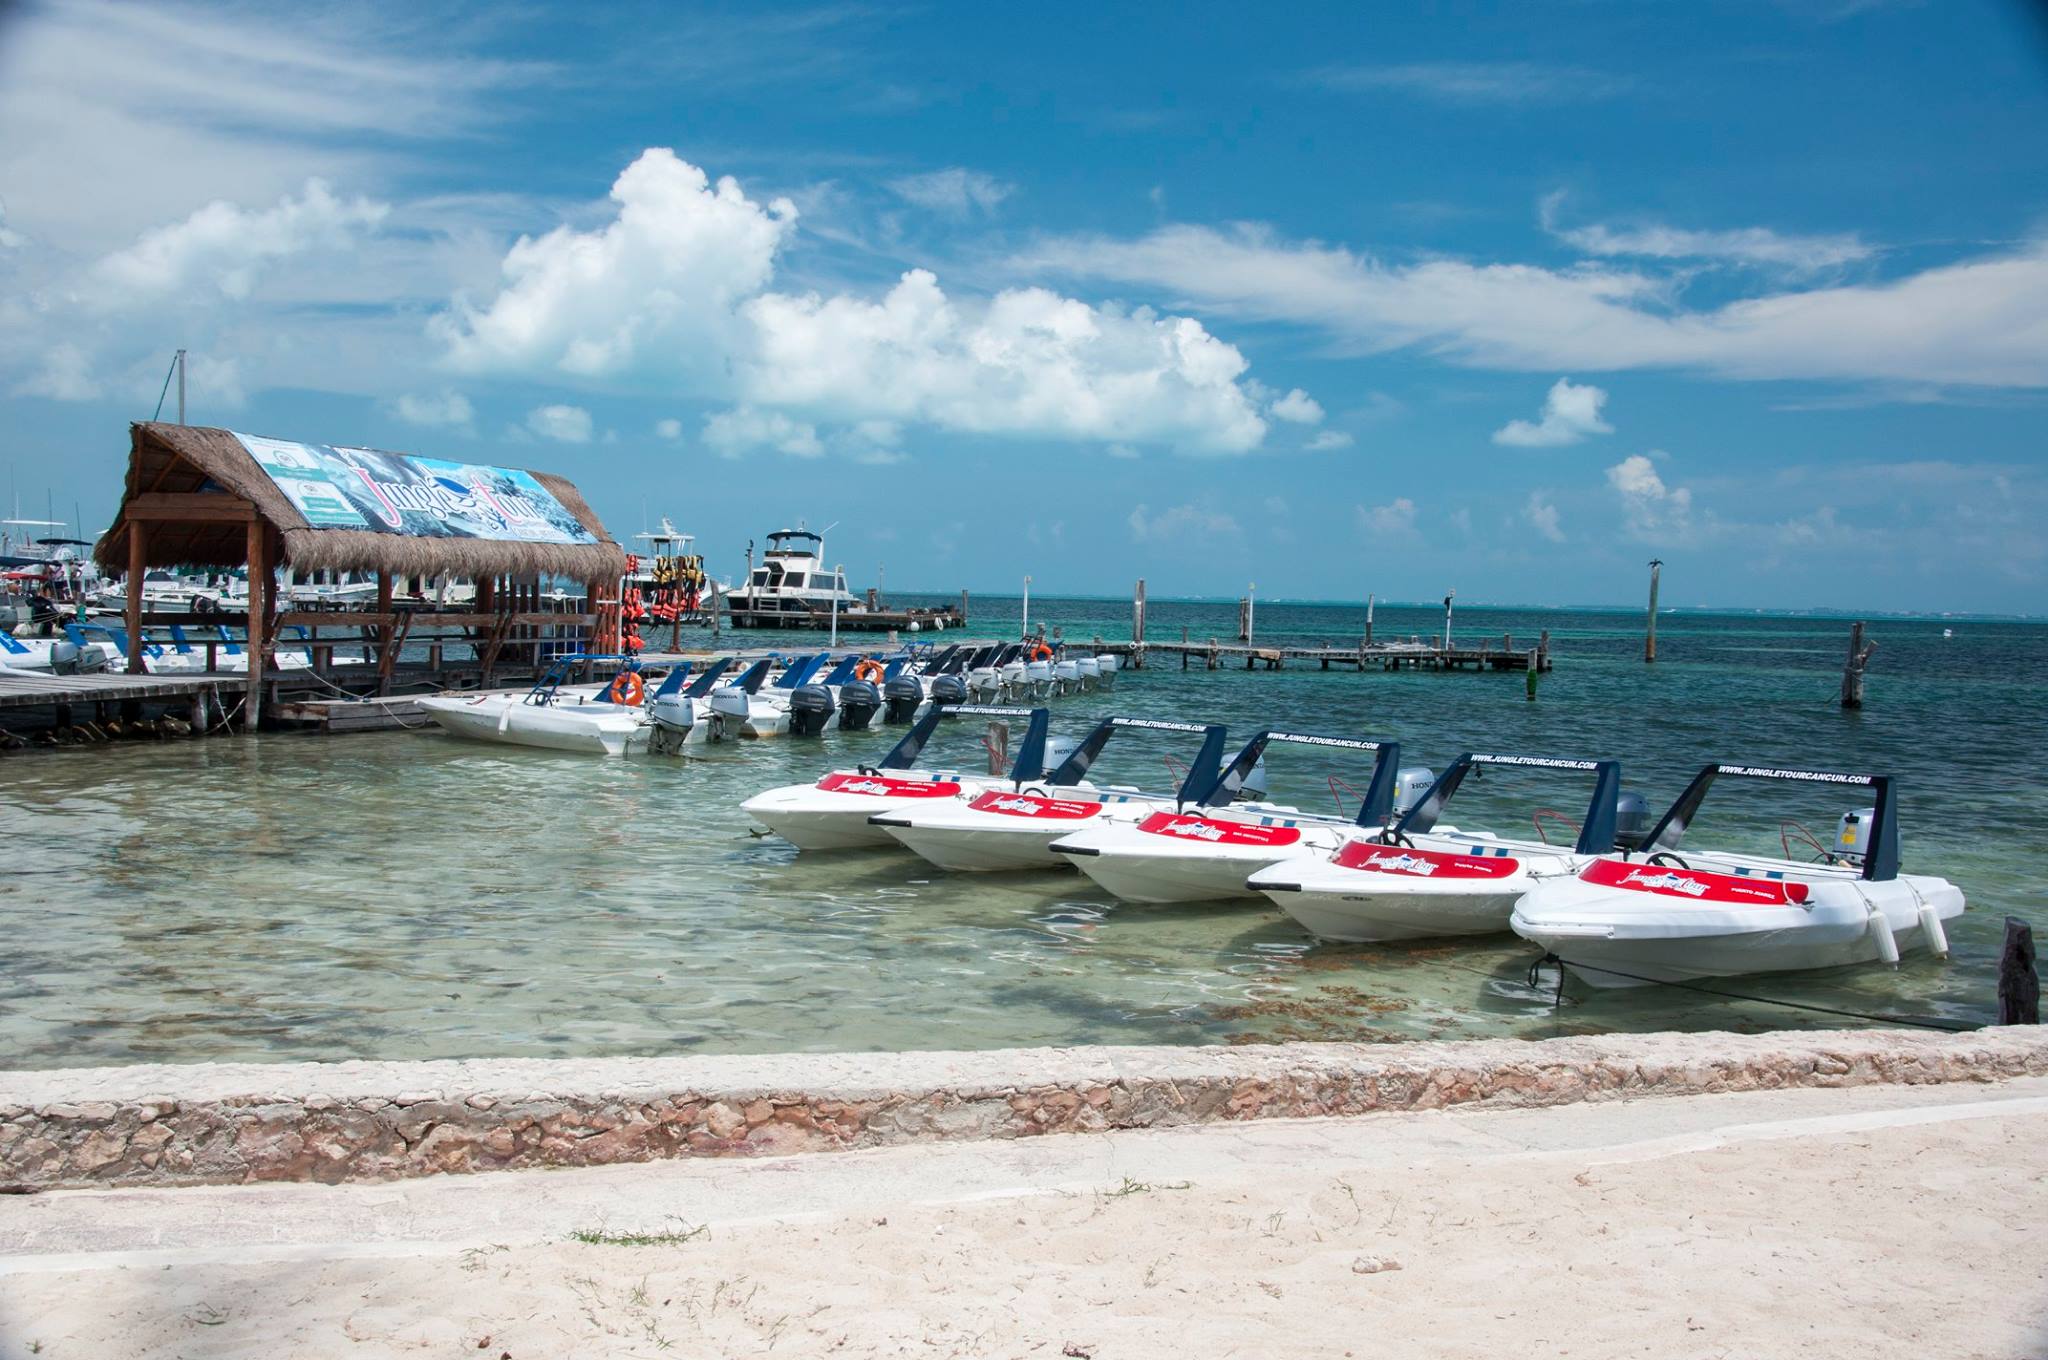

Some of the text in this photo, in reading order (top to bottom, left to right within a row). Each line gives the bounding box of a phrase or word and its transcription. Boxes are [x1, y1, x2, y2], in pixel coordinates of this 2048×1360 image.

[356, 466, 458, 527] Jungle
[1112, 718, 1206, 732] WWW.JUNGLETOURCANCUN.COM
[1267, 732, 1380, 750] WWW.JUNGLETOURCANCUN.COM
[1470, 754, 1598, 770] WWW.JUNGLETOURCANCUN.COM
[1718, 765, 1872, 784] WWW.JUNGLETOURCANCUN.COM
[1411, 781, 1434, 789] HON
